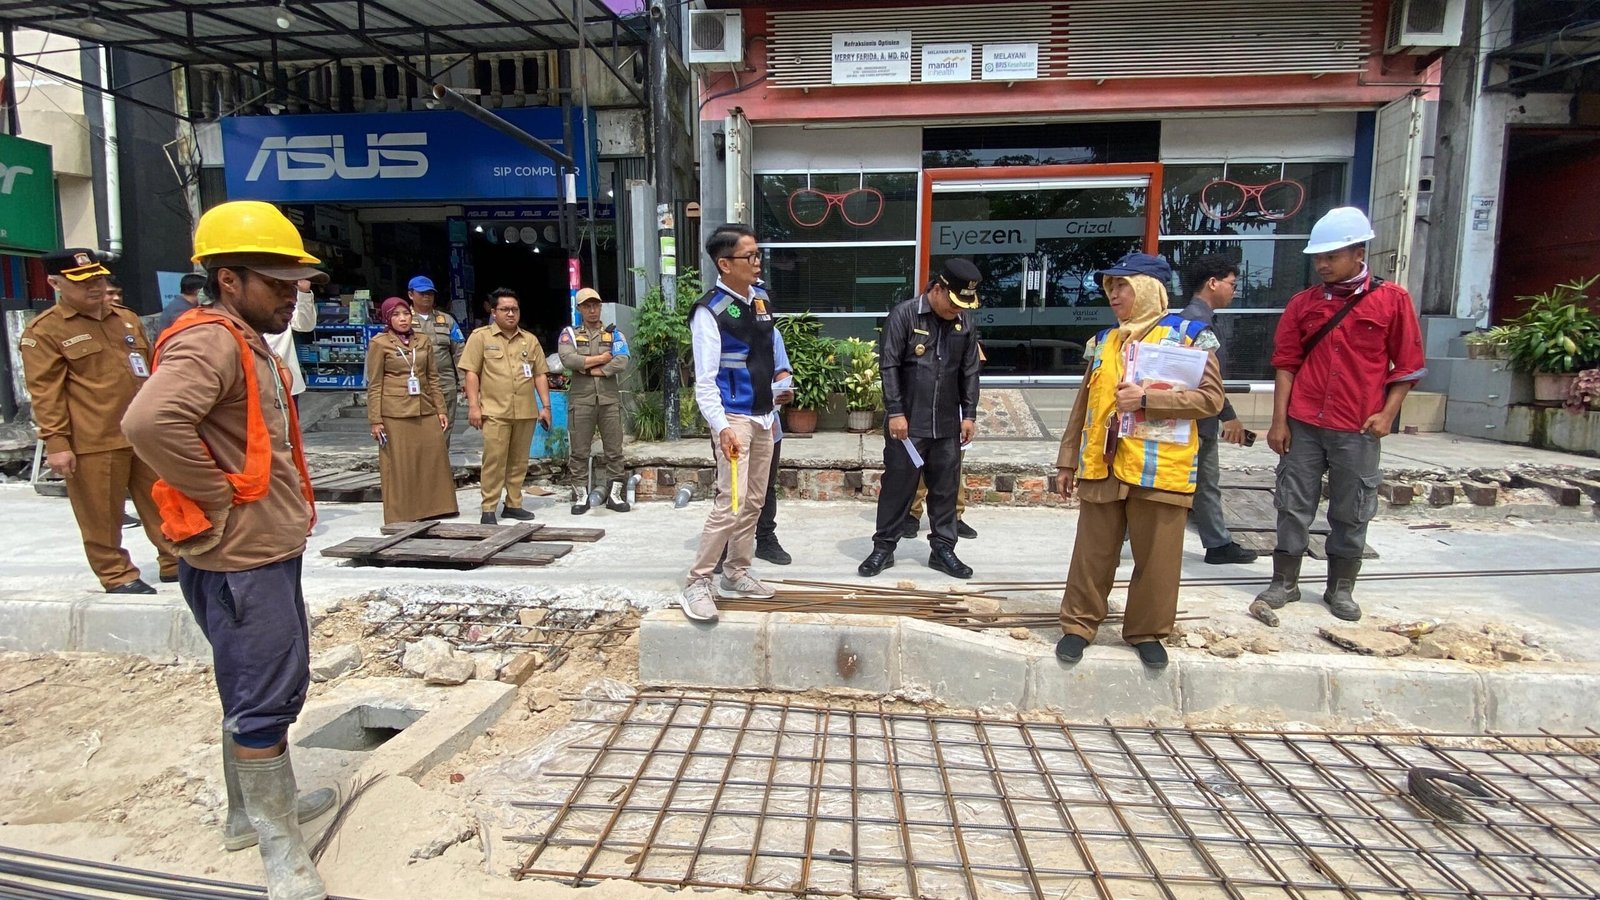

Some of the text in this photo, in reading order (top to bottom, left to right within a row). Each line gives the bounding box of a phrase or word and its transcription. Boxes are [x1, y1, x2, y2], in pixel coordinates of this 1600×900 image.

[834, 53, 855, 62] MERRY
[993, 52, 1026, 60] MELAYANI
[245, 132, 429, 182] ASUS
[493, 166, 512, 177] SIP
[1066, 220, 1113, 235] Crizal
[315, 376, 338, 384] ASUS
